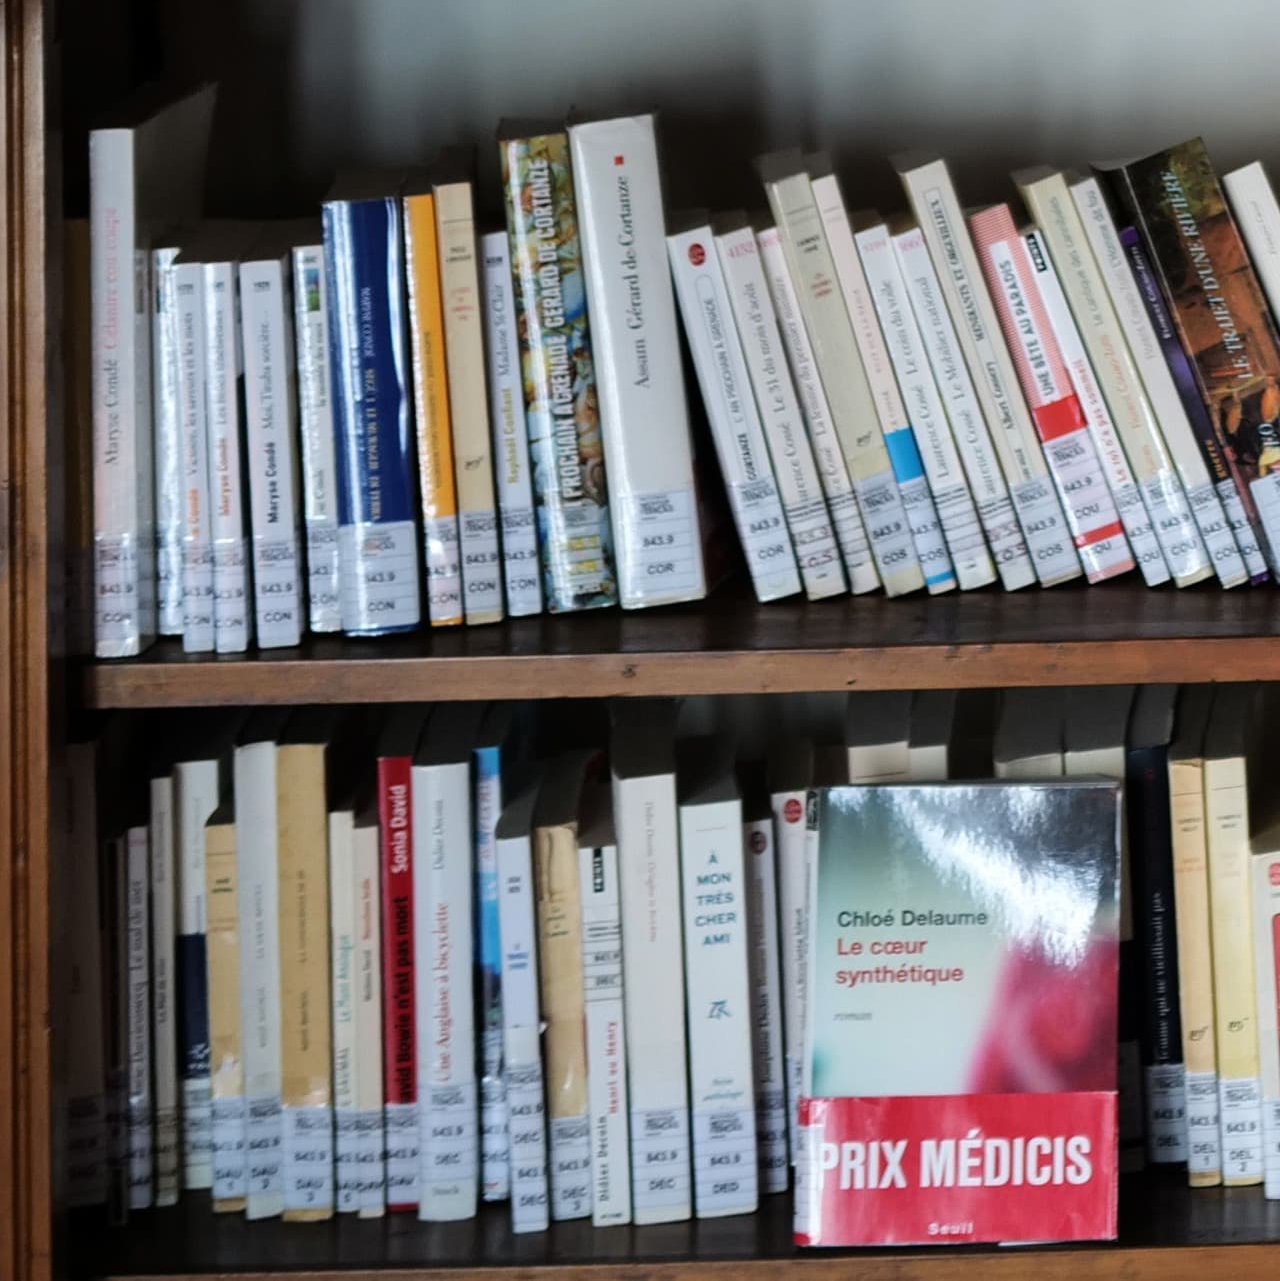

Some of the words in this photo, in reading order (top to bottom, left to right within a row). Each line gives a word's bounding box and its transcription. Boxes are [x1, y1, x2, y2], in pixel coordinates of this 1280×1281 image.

[529, 158, 558, 238] CORTANZE
[615, 175, 636, 246] Cortanze
[1160, 168, 1200, 236] RIVIÈRE
[541, 242, 559, 261] DE
[624, 251, 639, 269] de
[1190, 240, 1223, 289] D'UNE
[882, 279, 898, 307] voile
[1000, 260, 1030, 315] PARADIS
[624, 274, 644, 330] Gérard
[892, 310, 906, 327] du
[1021, 318, 1037, 336] AU
[1206, 294, 1245, 351] TRAJET
[755, 325, 771, 354] mois
[898, 329, 915, 357] coin
[1026, 339, 1047, 367] BÊTE
[548, 335, 572, 403] GRENADE
[633, 338, 651, 389] Assam
[761, 357, 776, 374] du
[906, 359, 919, 375] Le
[1234, 356, 1254, 378] LE
[766, 378, 782, 393] 31
[1038, 373, 1057, 396] UNE
[770, 394, 786, 413] Le
[553, 418, 584, 498] PROCHAIN
[921, 421, 950, 479] Laurence
[389, 785, 407, 827] David
[391, 831, 408, 873] Sonia
[697, 873, 731, 885] MON
[394, 897, 408, 935] mort
[696, 913, 736, 926] CHER
[837, 910, 894, 927] Chloé
[901, 910, 988, 926] Delaume
[395, 941, 410, 966] pas
[703, 934, 730, 945] AMI
[837, 937, 863, 956] Le
[870, 938, 927, 956] cœur
[835, 965, 963, 986] synthétique
[822, 1140, 907, 1188] PRIX
[920, 1129, 1091, 1188] MÉDICIS
[928, 1222, 973, 1235] Seuil
